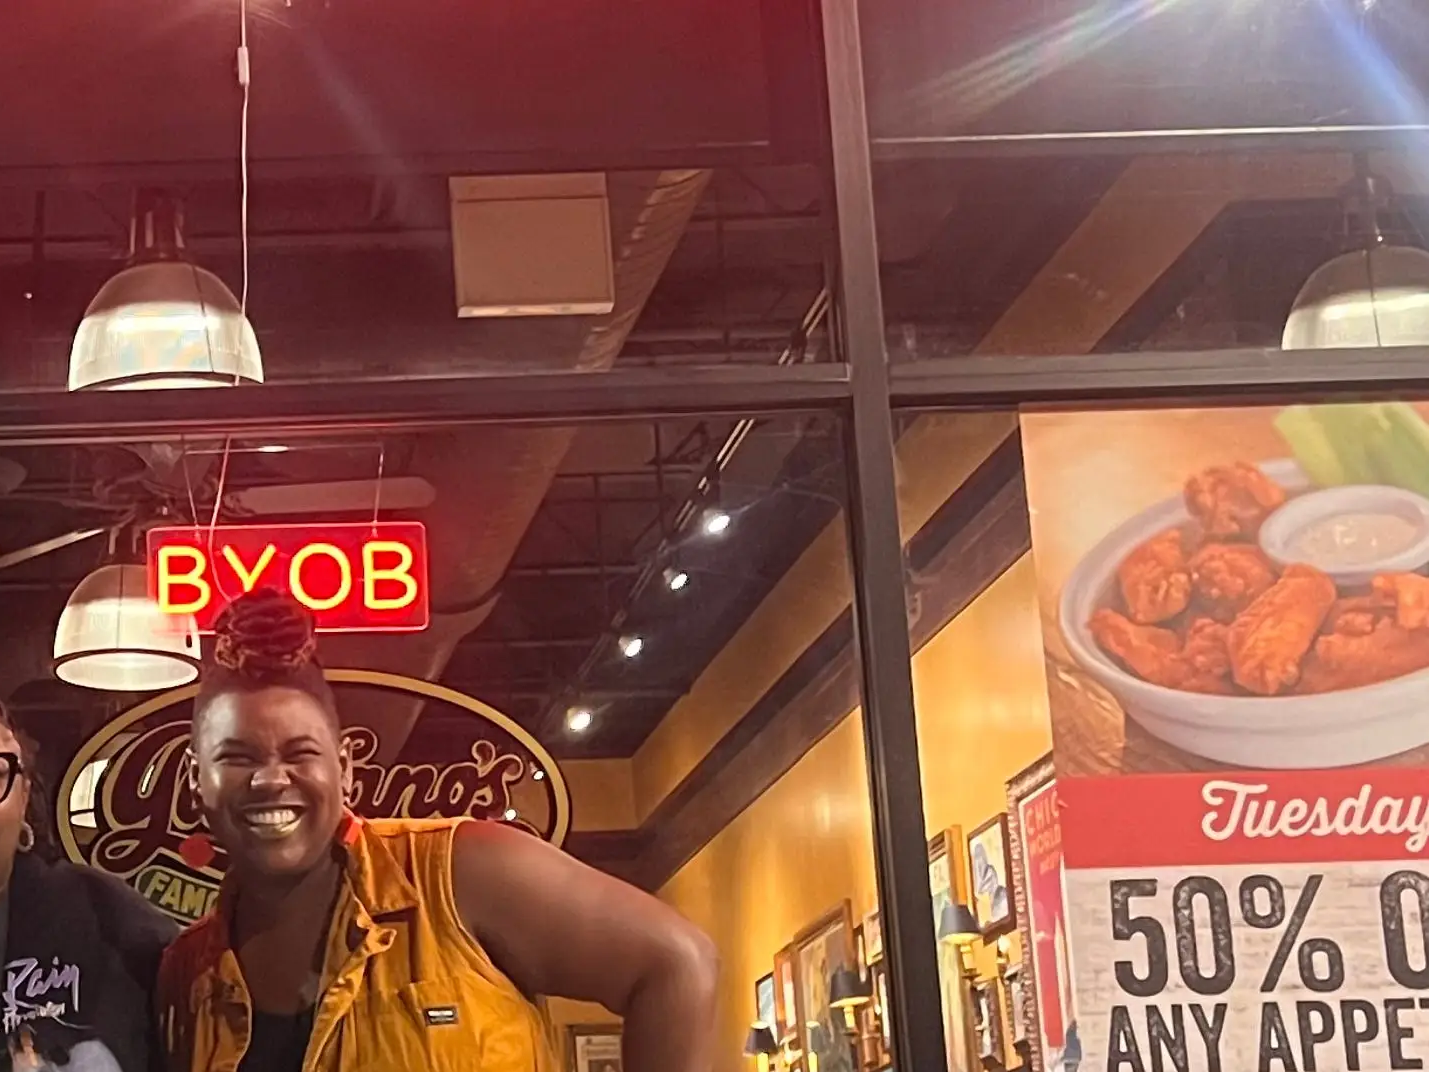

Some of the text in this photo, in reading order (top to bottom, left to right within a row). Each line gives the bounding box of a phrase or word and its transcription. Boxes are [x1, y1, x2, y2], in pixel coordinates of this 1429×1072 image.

[157, 541, 419, 614] BYOB
[1110, 873, 1346, 997] 50%
[2, 956, 80, 1014] Rain
